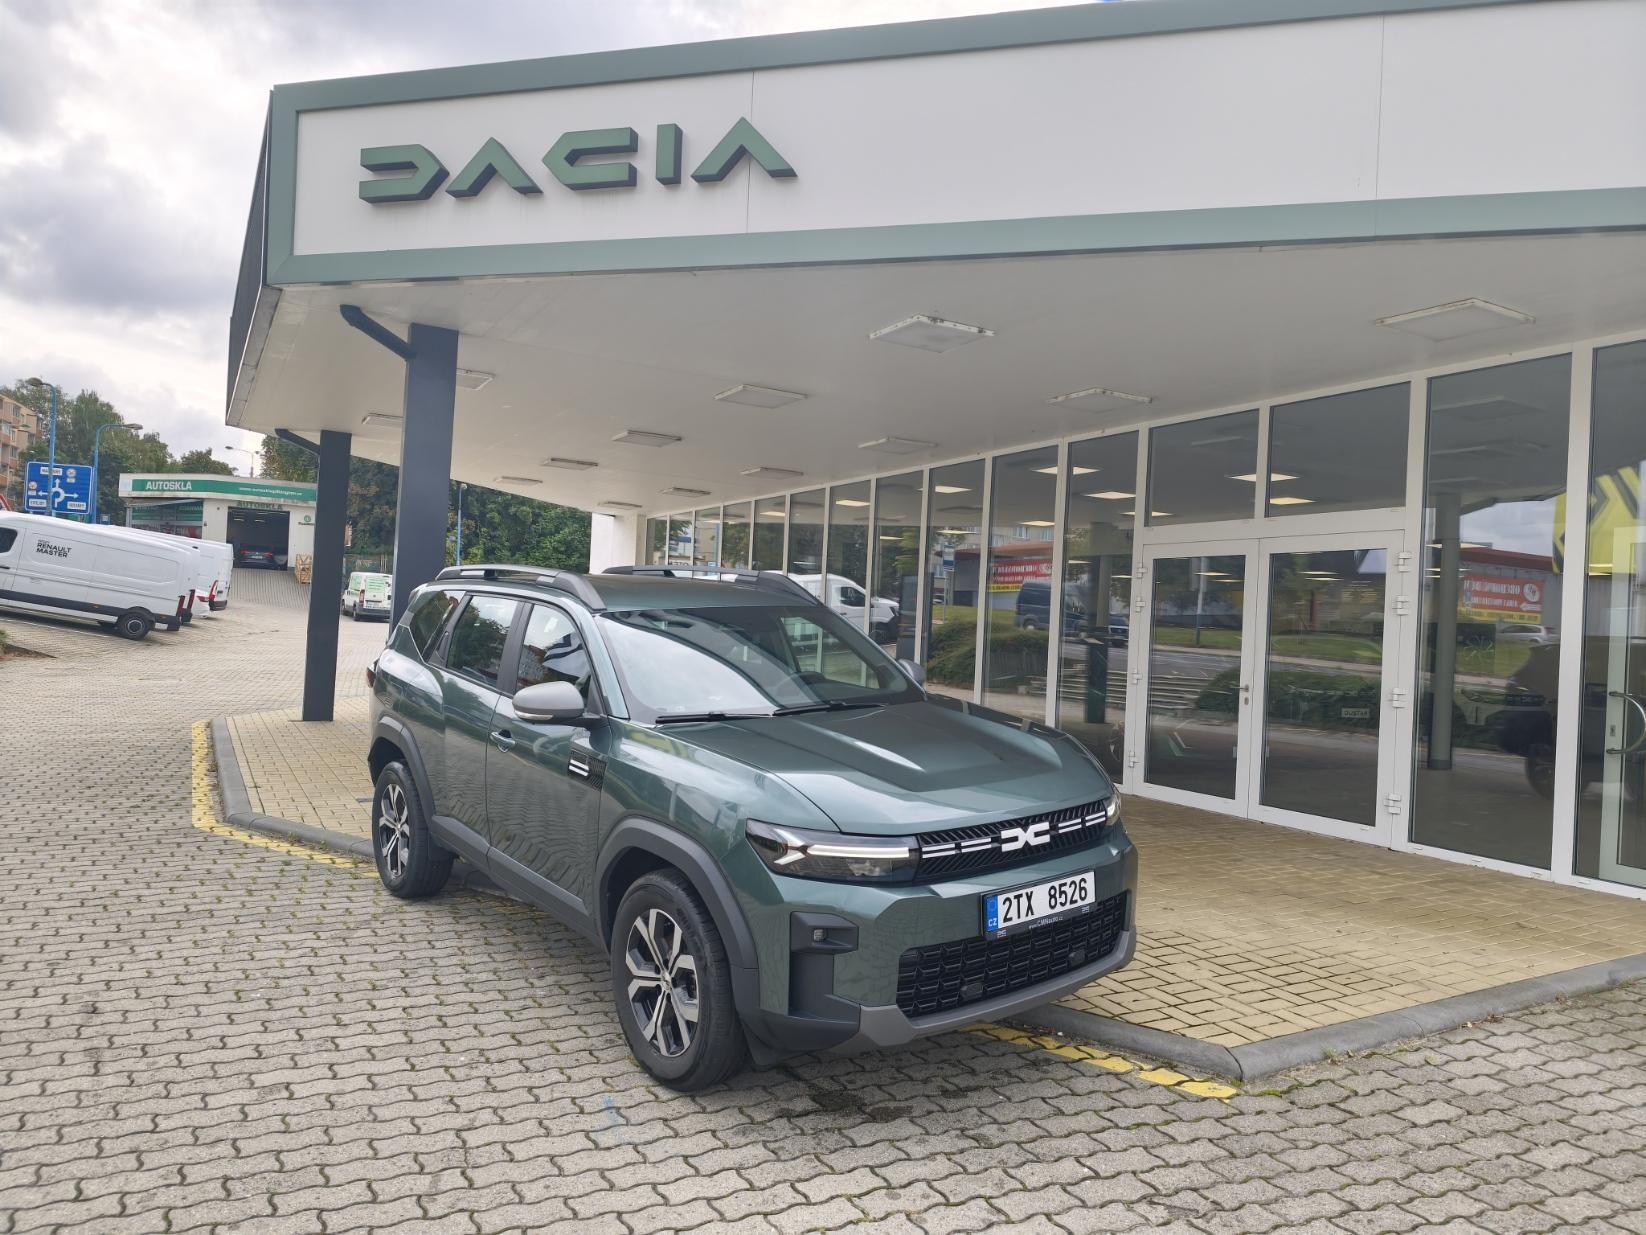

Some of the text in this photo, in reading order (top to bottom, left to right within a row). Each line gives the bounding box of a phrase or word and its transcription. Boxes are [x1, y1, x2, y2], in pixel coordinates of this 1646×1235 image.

[359, 115, 798, 205] DACIA
[145, 481, 193, 491] AUTOSKLA
[36, 547, 68, 558] MASTER
[37, 543, 72, 553] RENAULT
[1002, 877, 1088, 924] 2TX 8526
[988, 918, 998, 927] CZ
